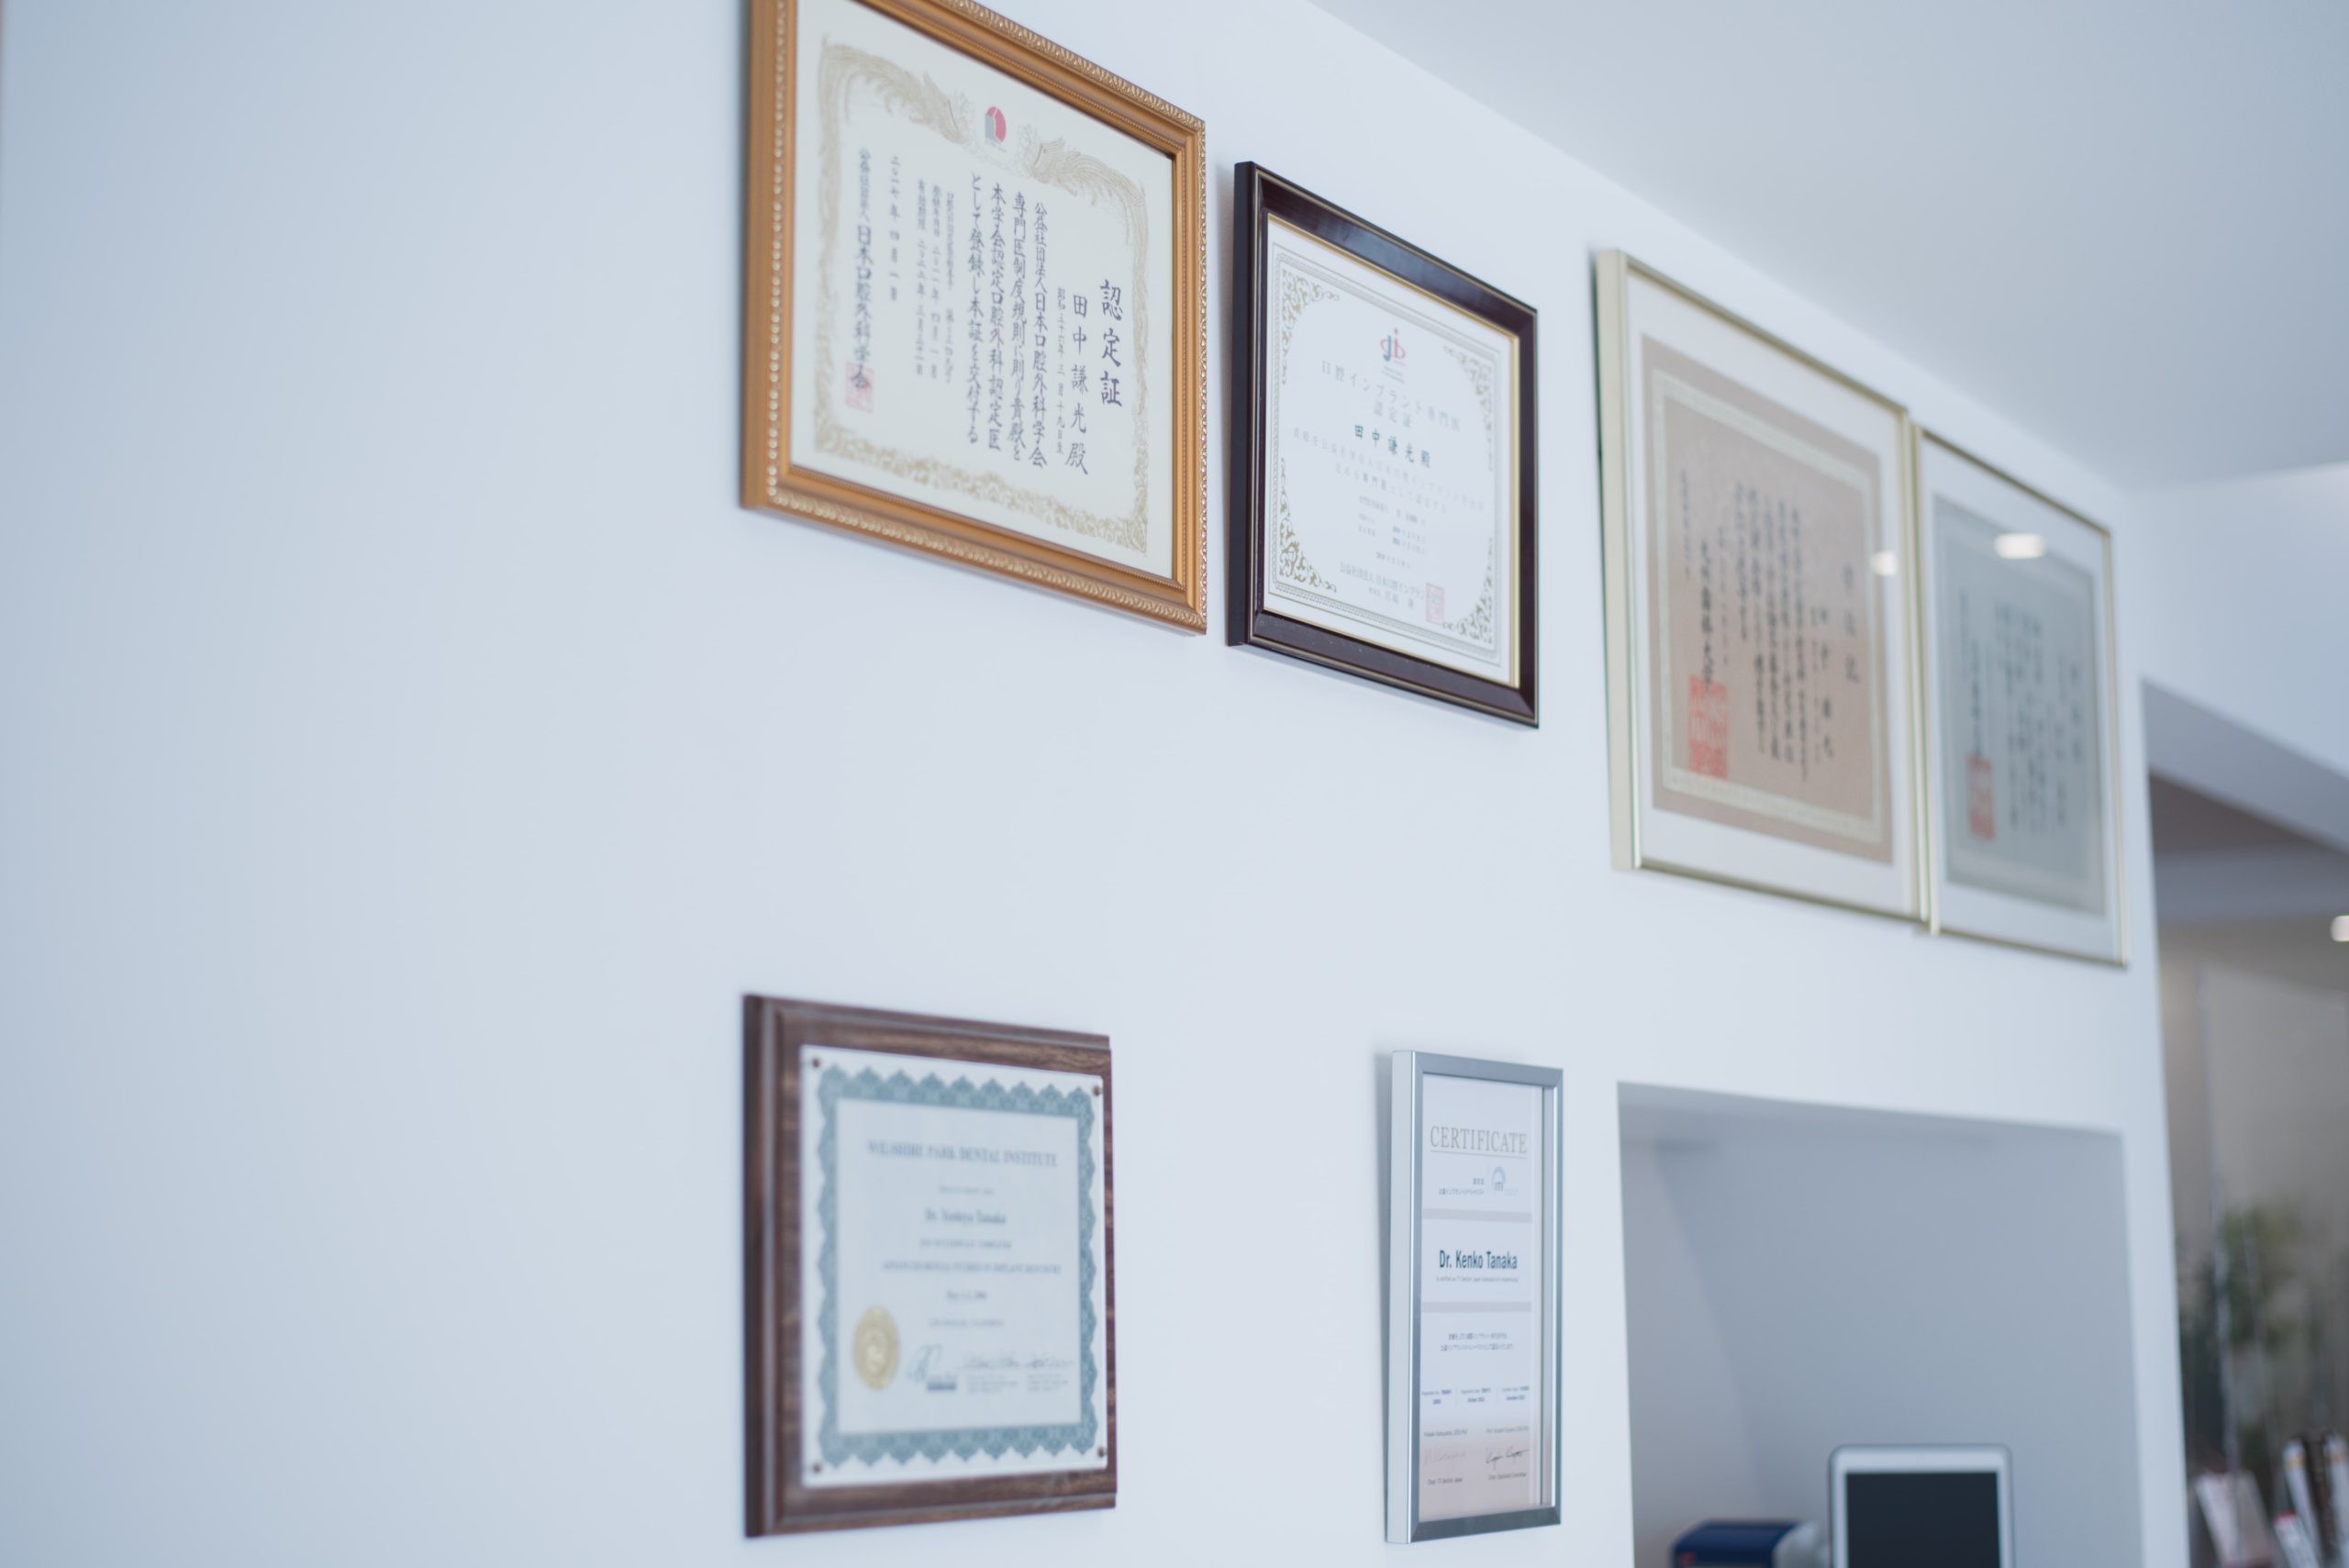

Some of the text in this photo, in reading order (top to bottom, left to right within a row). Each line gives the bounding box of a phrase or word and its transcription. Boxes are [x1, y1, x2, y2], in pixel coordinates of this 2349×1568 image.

[1008, 191, 1028, 462] 専門医制度規則に則り貴殿を
[1030, 202, 1048, 469] 公益社団法人日本口腔外科学会
[1065, 295, 1088, 475] 田中謙光殿
[1100, 279, 1123, 407] 認定証
[1431, 1125, 1528, 1154] CERTIFICATE
[1439, 1250, 1518, 1270] Dr. Kenko Tanaka
